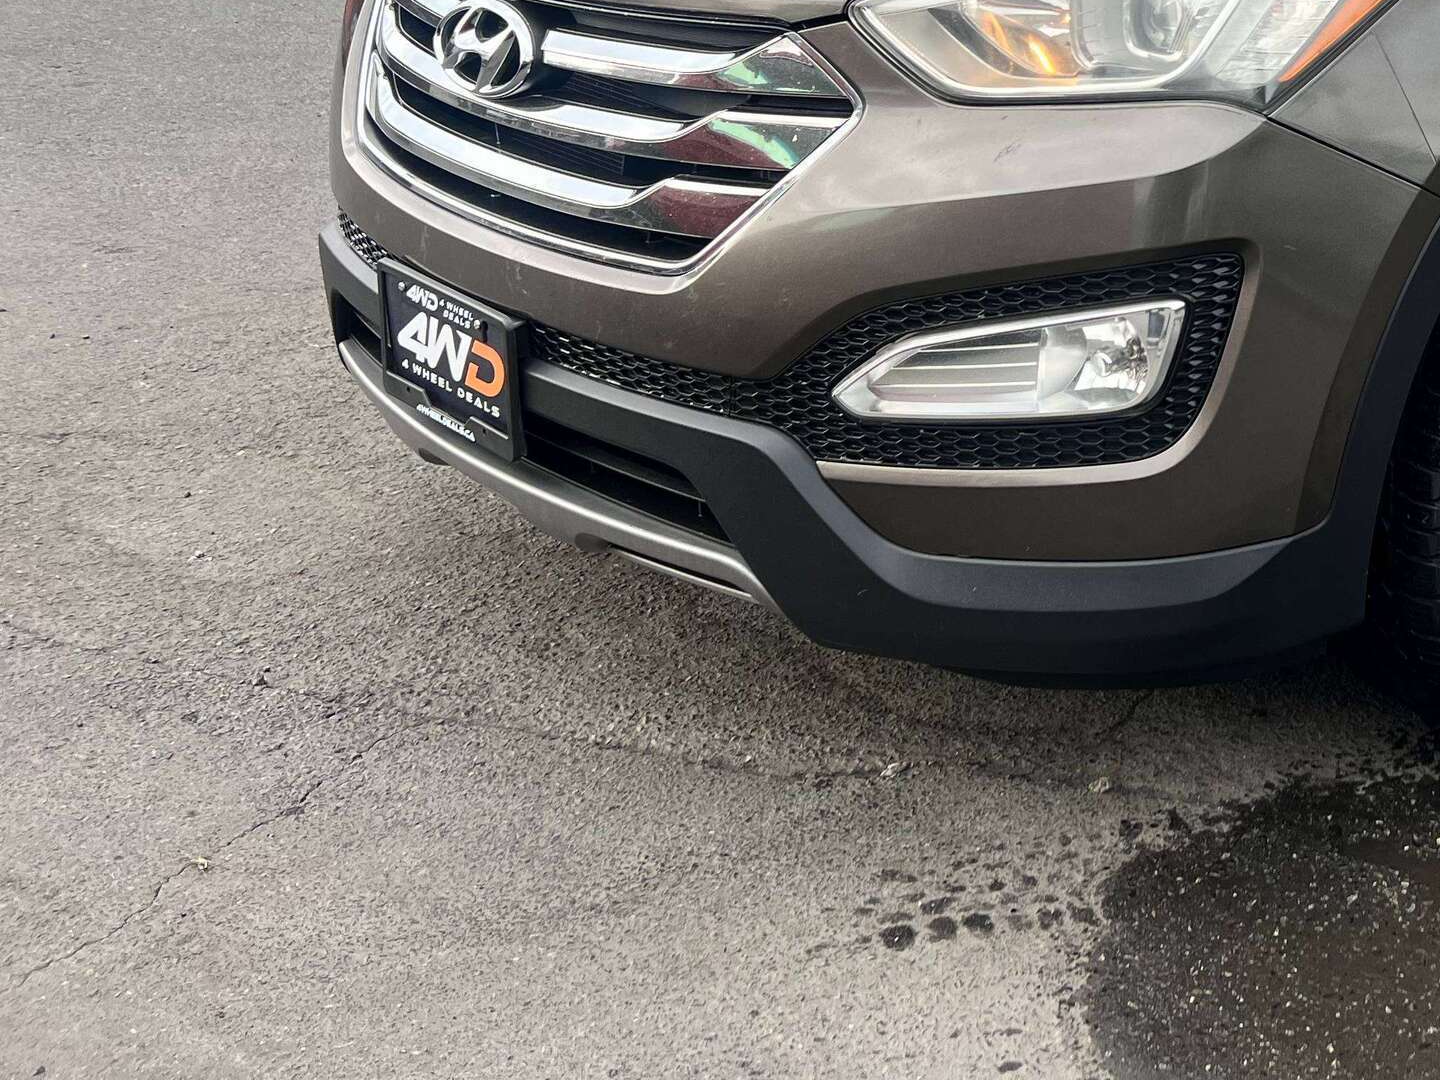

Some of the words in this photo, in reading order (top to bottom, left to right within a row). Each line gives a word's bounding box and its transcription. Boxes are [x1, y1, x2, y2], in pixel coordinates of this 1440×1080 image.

[406, 284, 438, 311] 4WD
[439, 298, 445, 307] 4
[446, 301, 474, 321] WHEEL
[443, 309, 471, 329] DEALS
[397, 311, 505, 398] 4WD
[401, 358, 410, 369] 4
[412, 363, 453, 393] WHEEL
[457, 387, 501, 419] DEALS
